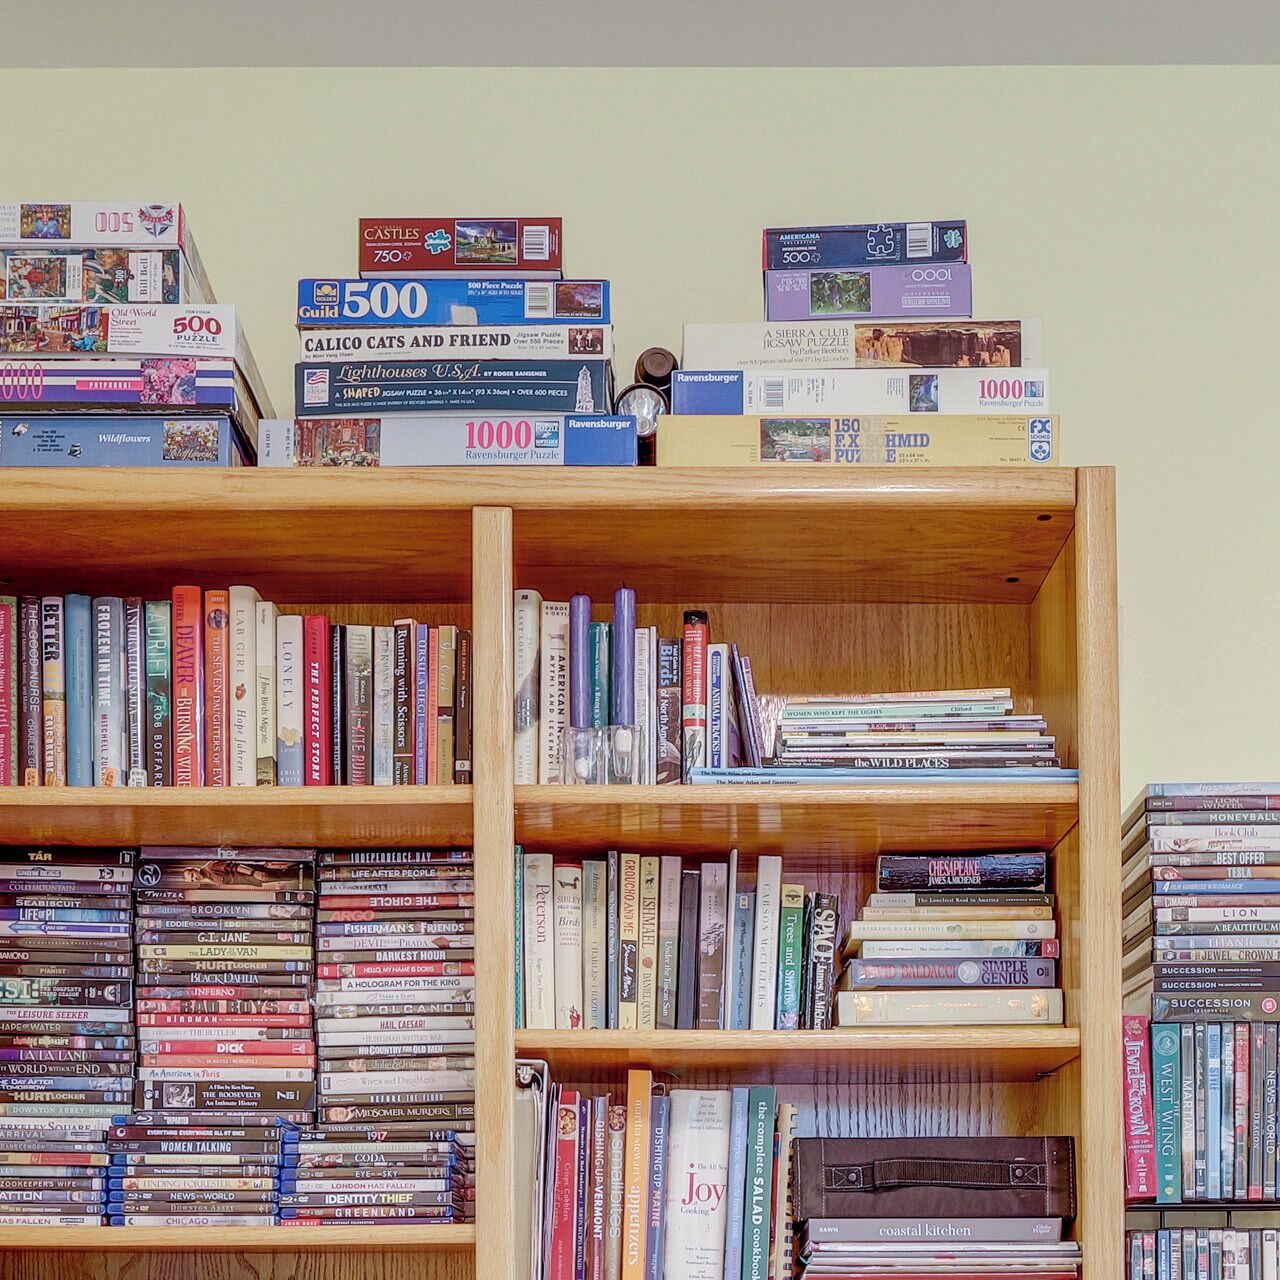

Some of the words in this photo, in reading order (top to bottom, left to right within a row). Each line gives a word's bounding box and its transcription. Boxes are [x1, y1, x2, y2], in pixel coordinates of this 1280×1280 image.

[364, 228, 419, 241] CASTLES
[373, 250, 402, 262] 750
[782, 252, 811, 264] 500
[140, 258, 148, 277] Bell
[140, 279, 148, 296] Bill
[342, 282, 429, 318] 500
[111, 308, 127, 319] Old
[130, 308, 158, 318] World
[299, 305, 340, 319] Guild
[111, 318, 137, 326] Street
[172, 318, 222, 334] 500
[177, 334, 218, 343] PUZZLE
[763, 329, 771, 338] A
[775, 328, 811, 338] SIERRA
[815, 328, 849, 338] CLUB
[305, 338, 362, 352] CALICO
[366, 337, 406, 350] CATS
[410, 335, 444, 348] AND
[449, 333, 511, 347] FRIEND
[763, 338, 802, 350] JIGSAW
[806, 338, 849, 348] PUZZLE
[336, 364, 427, 382] Lighthouses
[677, 373, 739, 384] Ravensburger
[979, 379, 1023, 400] 1000
[569, 420, 631, 430] Ravensburger
[98, 432, 151, 444] Wildflowers
[465, 420, 532, 450] 1000
[28, 604, 38, 627] THE
[44, 604, 60, 662] BETTER
[98, 605, 110, 654] FROZEN
[28, 630, 39, 668] GOOD
[148, 612, 168, 679] ADRIFT
[395, 629, 408, 676] Running
[177, 625, 194, 685] DEAVER
[98, 659, 110, 673] IN
[310, 662, 319, 684] THE
[661, 645, 672, 686] Birds
[283, 641, 293, 711] LONELY
[29, 672, 40, 712] NURSE
[98, 677, 110, 707] TIME
[396, 678, 407, 702] with
[154, 705, 162, 728] ROB
[311, 689, 319, 739] PERFECT
[397, 705, 408, 747] Scissors
[312, 742, 320, 780] STORM
[1209, 813, 1277, 821] MONEYBALL
[28, 851, 52, 861] TÁR
[928, 861, 980, 877] CHESAPEAKE
[624, 859, 636, 901] GROUCHO
[191, 906, 250, 914] BROOKLYN
[329, 911, 376, 921] ARGO
[536, 884, 550, 943] Peterson
[624, 904, 634, 919] AND
[1223, 909, 1258, 917] LION
[624, 921, 634, 934] ME
[642, 896, 656, 949] ISHMAEL
[785, 914, 797, 944] Trees
[376, 952, 417, 961] DARKEST
[420, 951, 446, 960] HOUR
[785, 947, 794, 965] and
[982, 960, 1027, 973] SIMPLE
[783, 969, 795, 1005] Shrubs
[982, 972, 1028, 985] GENIUS
[194, 988, 235, 996] INFERNO
[1171, 999, 1251, 1008] SUCCESSION
[1267, 1070, 1276, 1103] NEWS
[1267, 1113, 1275, 1153] WORLD
[161, 1142, 192, 1152] WOMEN
[196, 1142, 232, 1152] TALKING
[325, 1194, 378, 1204] IDENTITY
[380, 1194, 413, 1203] THIEF
[752, 1177, 764, 1225] SALAD
[335, 1208, 415, 1217] GREENLAND
[880, 1224, 922, 1237] coastal
[926, 1224, 971, 1236] kitchen
